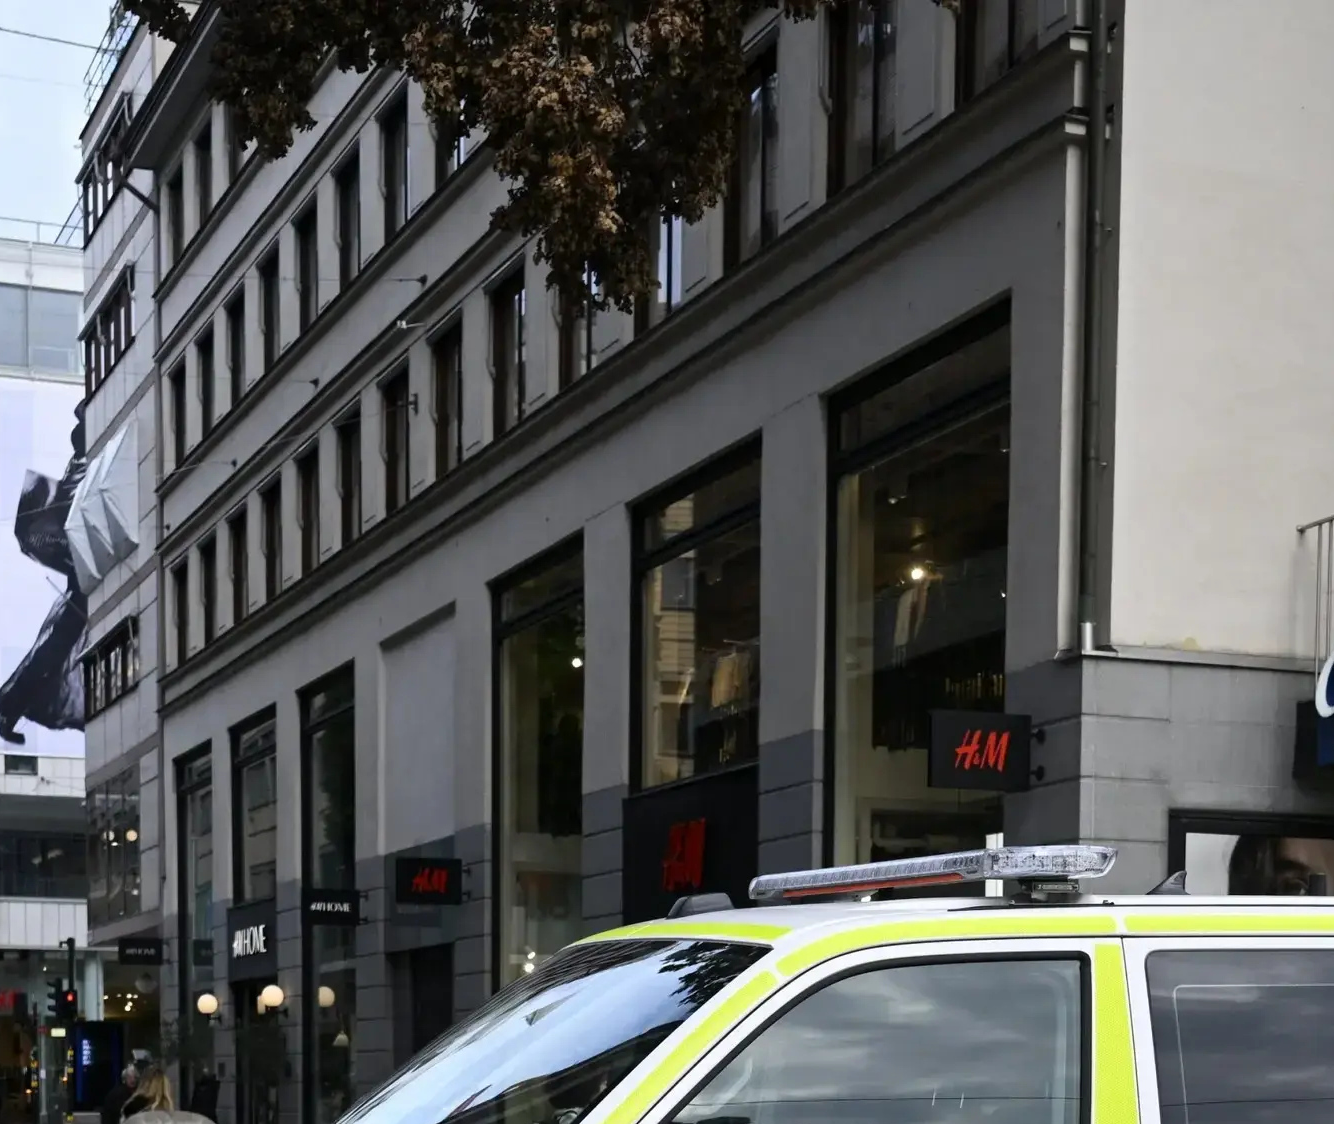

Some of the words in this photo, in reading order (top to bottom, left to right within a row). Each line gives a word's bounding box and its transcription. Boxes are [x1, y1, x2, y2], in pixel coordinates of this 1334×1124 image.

[953, 729, 1011, 773] H&M
[661, 817, 707, 892] H&M
[326, 902, 352, 912] HOME
[244, 924, 267, 956] HOME
